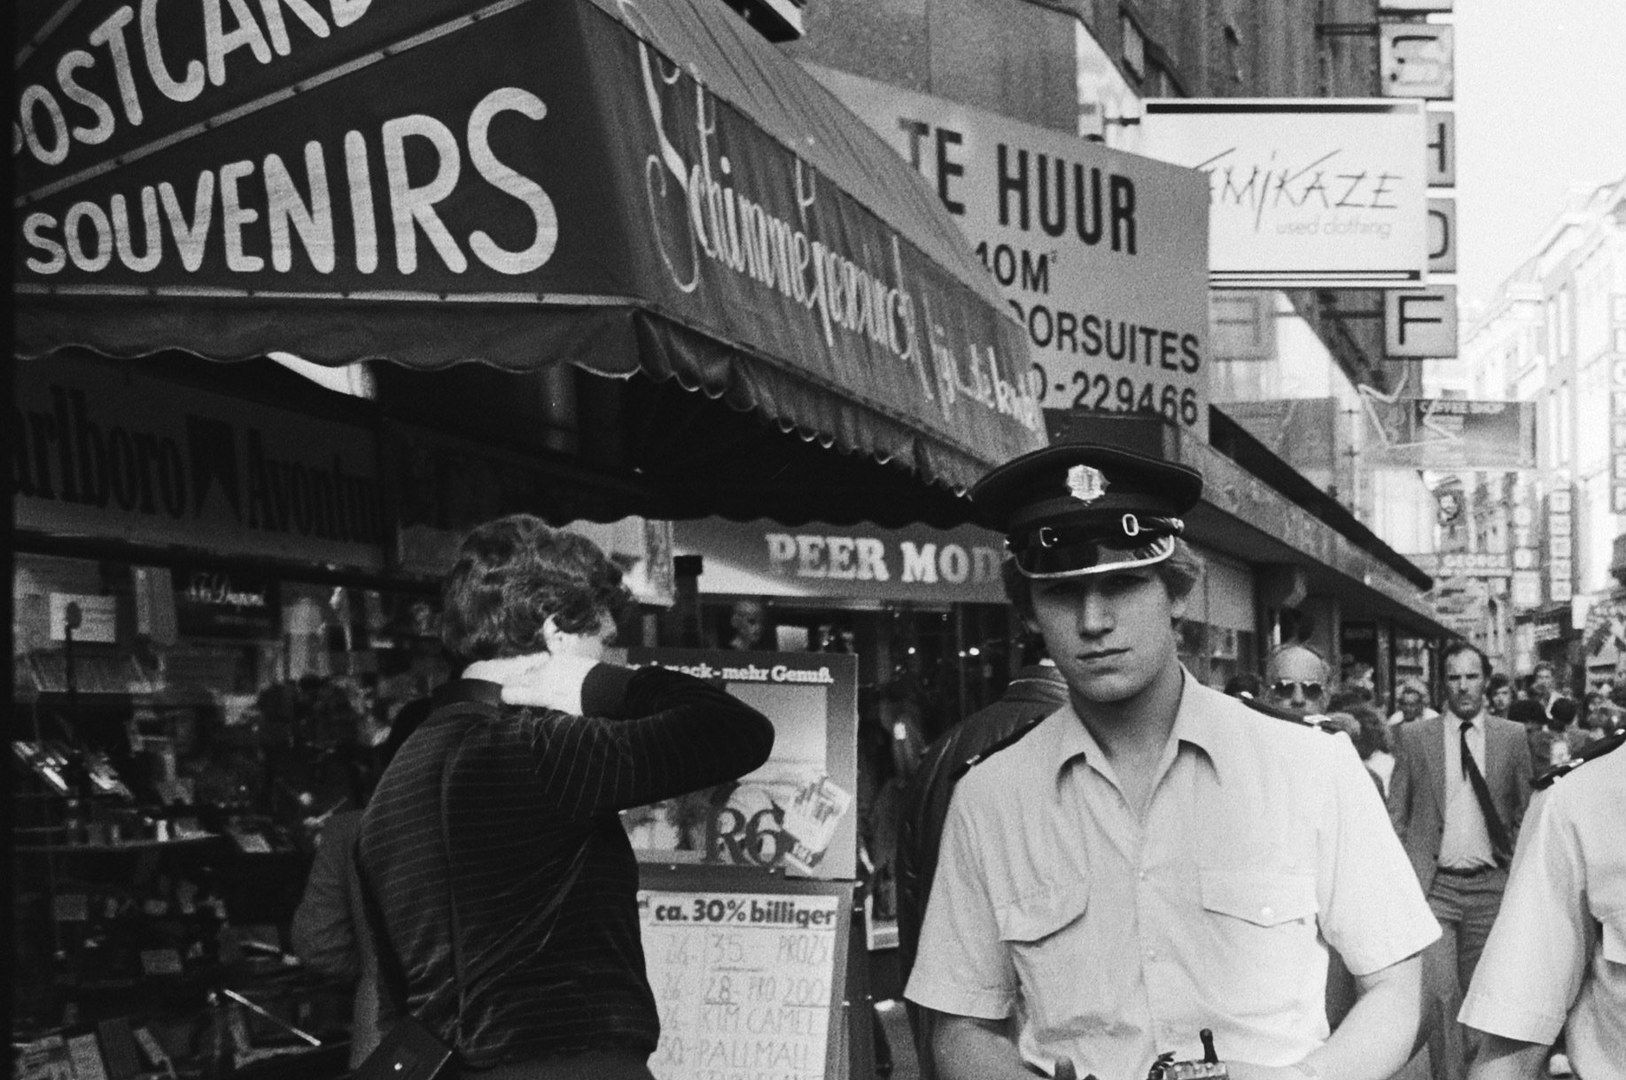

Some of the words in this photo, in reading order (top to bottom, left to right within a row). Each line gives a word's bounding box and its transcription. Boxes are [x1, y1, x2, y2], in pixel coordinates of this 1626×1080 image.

[12, 0, 373, 164] OSTCA
[23, 86, 558, 274] SOUVENIRS
[898, 116, 965, 215] TE
[997, 143, 1137, 256] HUUR
[1195, 146, 1404, 233] MIKAZE
[1008, 300, 1200, 374] ORSUITES
[763, 533, 890, 581] PEER
[656, 903, 688, 922] ca.
[693, 899, 747, 923] 30%
[750, 900, 836, 928] billiger
